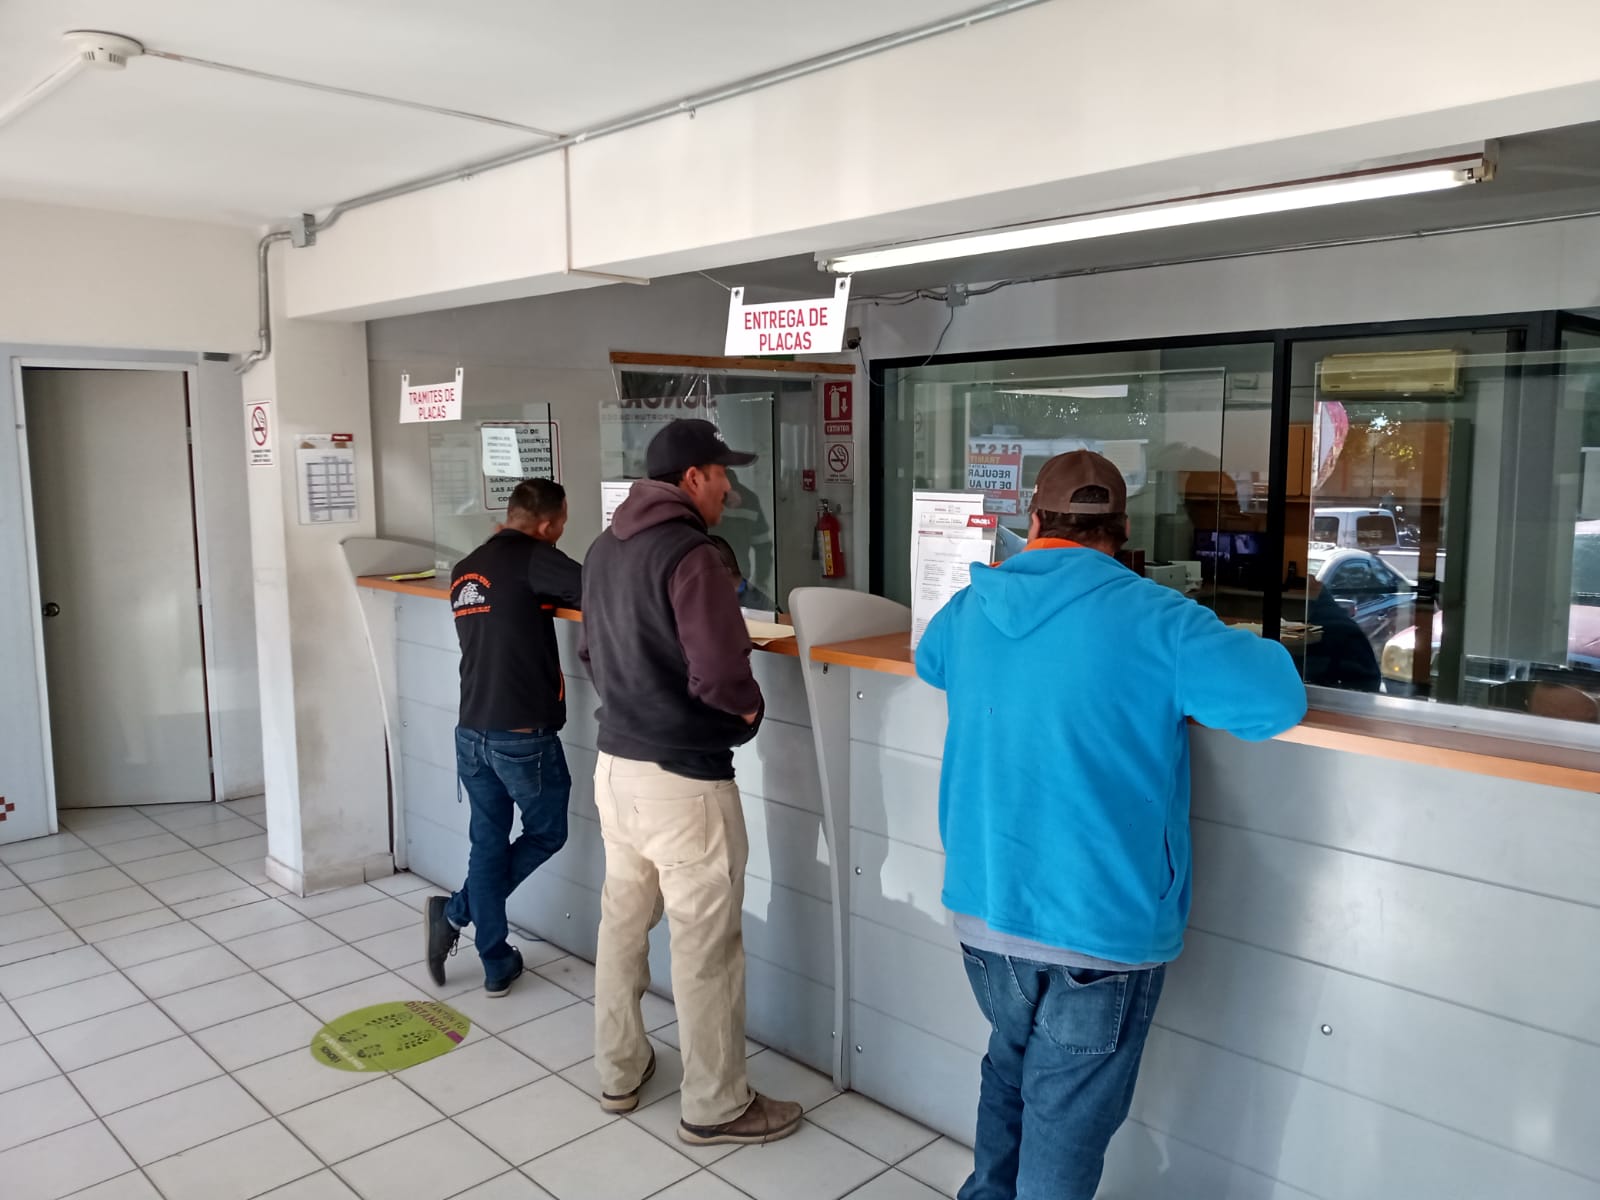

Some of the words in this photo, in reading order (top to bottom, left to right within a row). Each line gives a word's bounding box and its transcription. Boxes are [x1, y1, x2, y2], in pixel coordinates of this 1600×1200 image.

[744, 308, 805, 330] ENTREGA
[809, 306, 828, 326] DE
[759, 331, 812, 351] PLACAS
[408, 389, 443, 405] TRAMITES
[445, 388, 455, 402] DE
[418, 405, 447, 420] PLACAS
